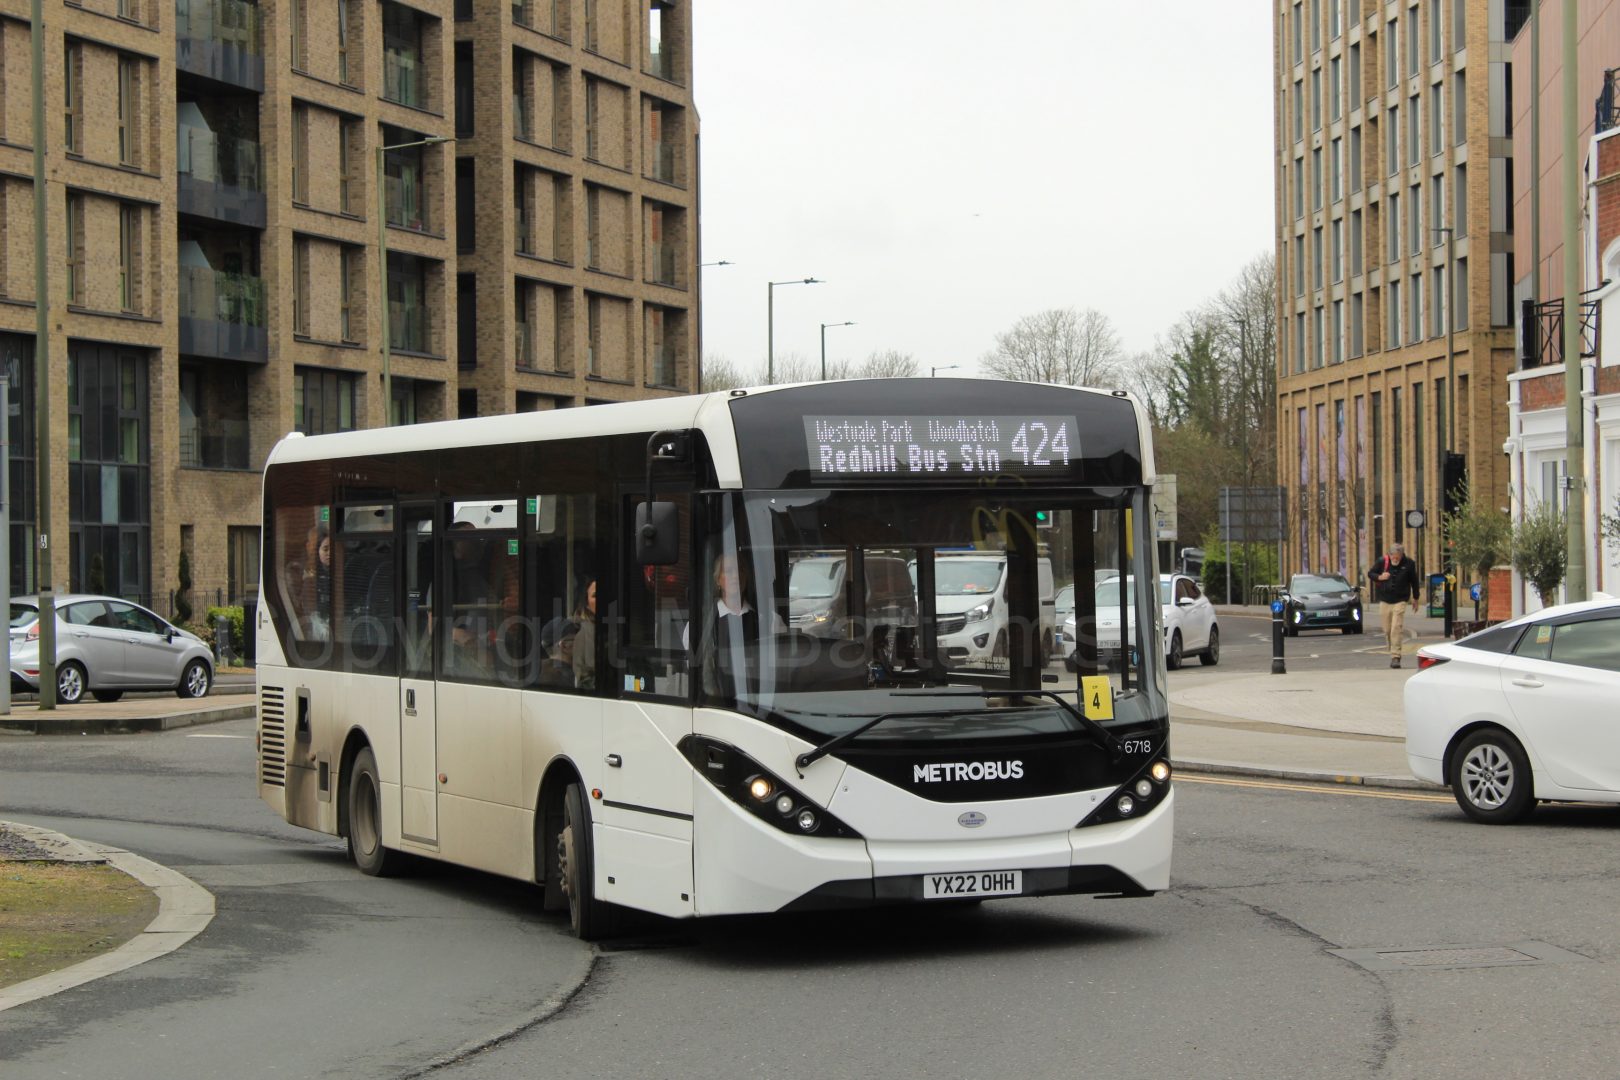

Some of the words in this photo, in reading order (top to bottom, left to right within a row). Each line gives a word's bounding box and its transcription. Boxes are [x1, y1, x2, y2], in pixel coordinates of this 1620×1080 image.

[816, 420, 877, 442] Westvale
[882, 420, 913, 442] Park
[929, 420, 999, 442] Woodhatch
[1011, 422, 1070, 466] 424
[819, 444, 896, 473] Redhill
[908, 444, 949, 472] Bus
[960, 444, 1000, 472] Stn
[1092, 692, 1101, 710] 4
[1124, 740, 1151, 754] 6718
[913, 760, 1024, 783] METROBUS
[931, 875, 977, 895] YX22
[981, 872, 1015, 892] OHH
